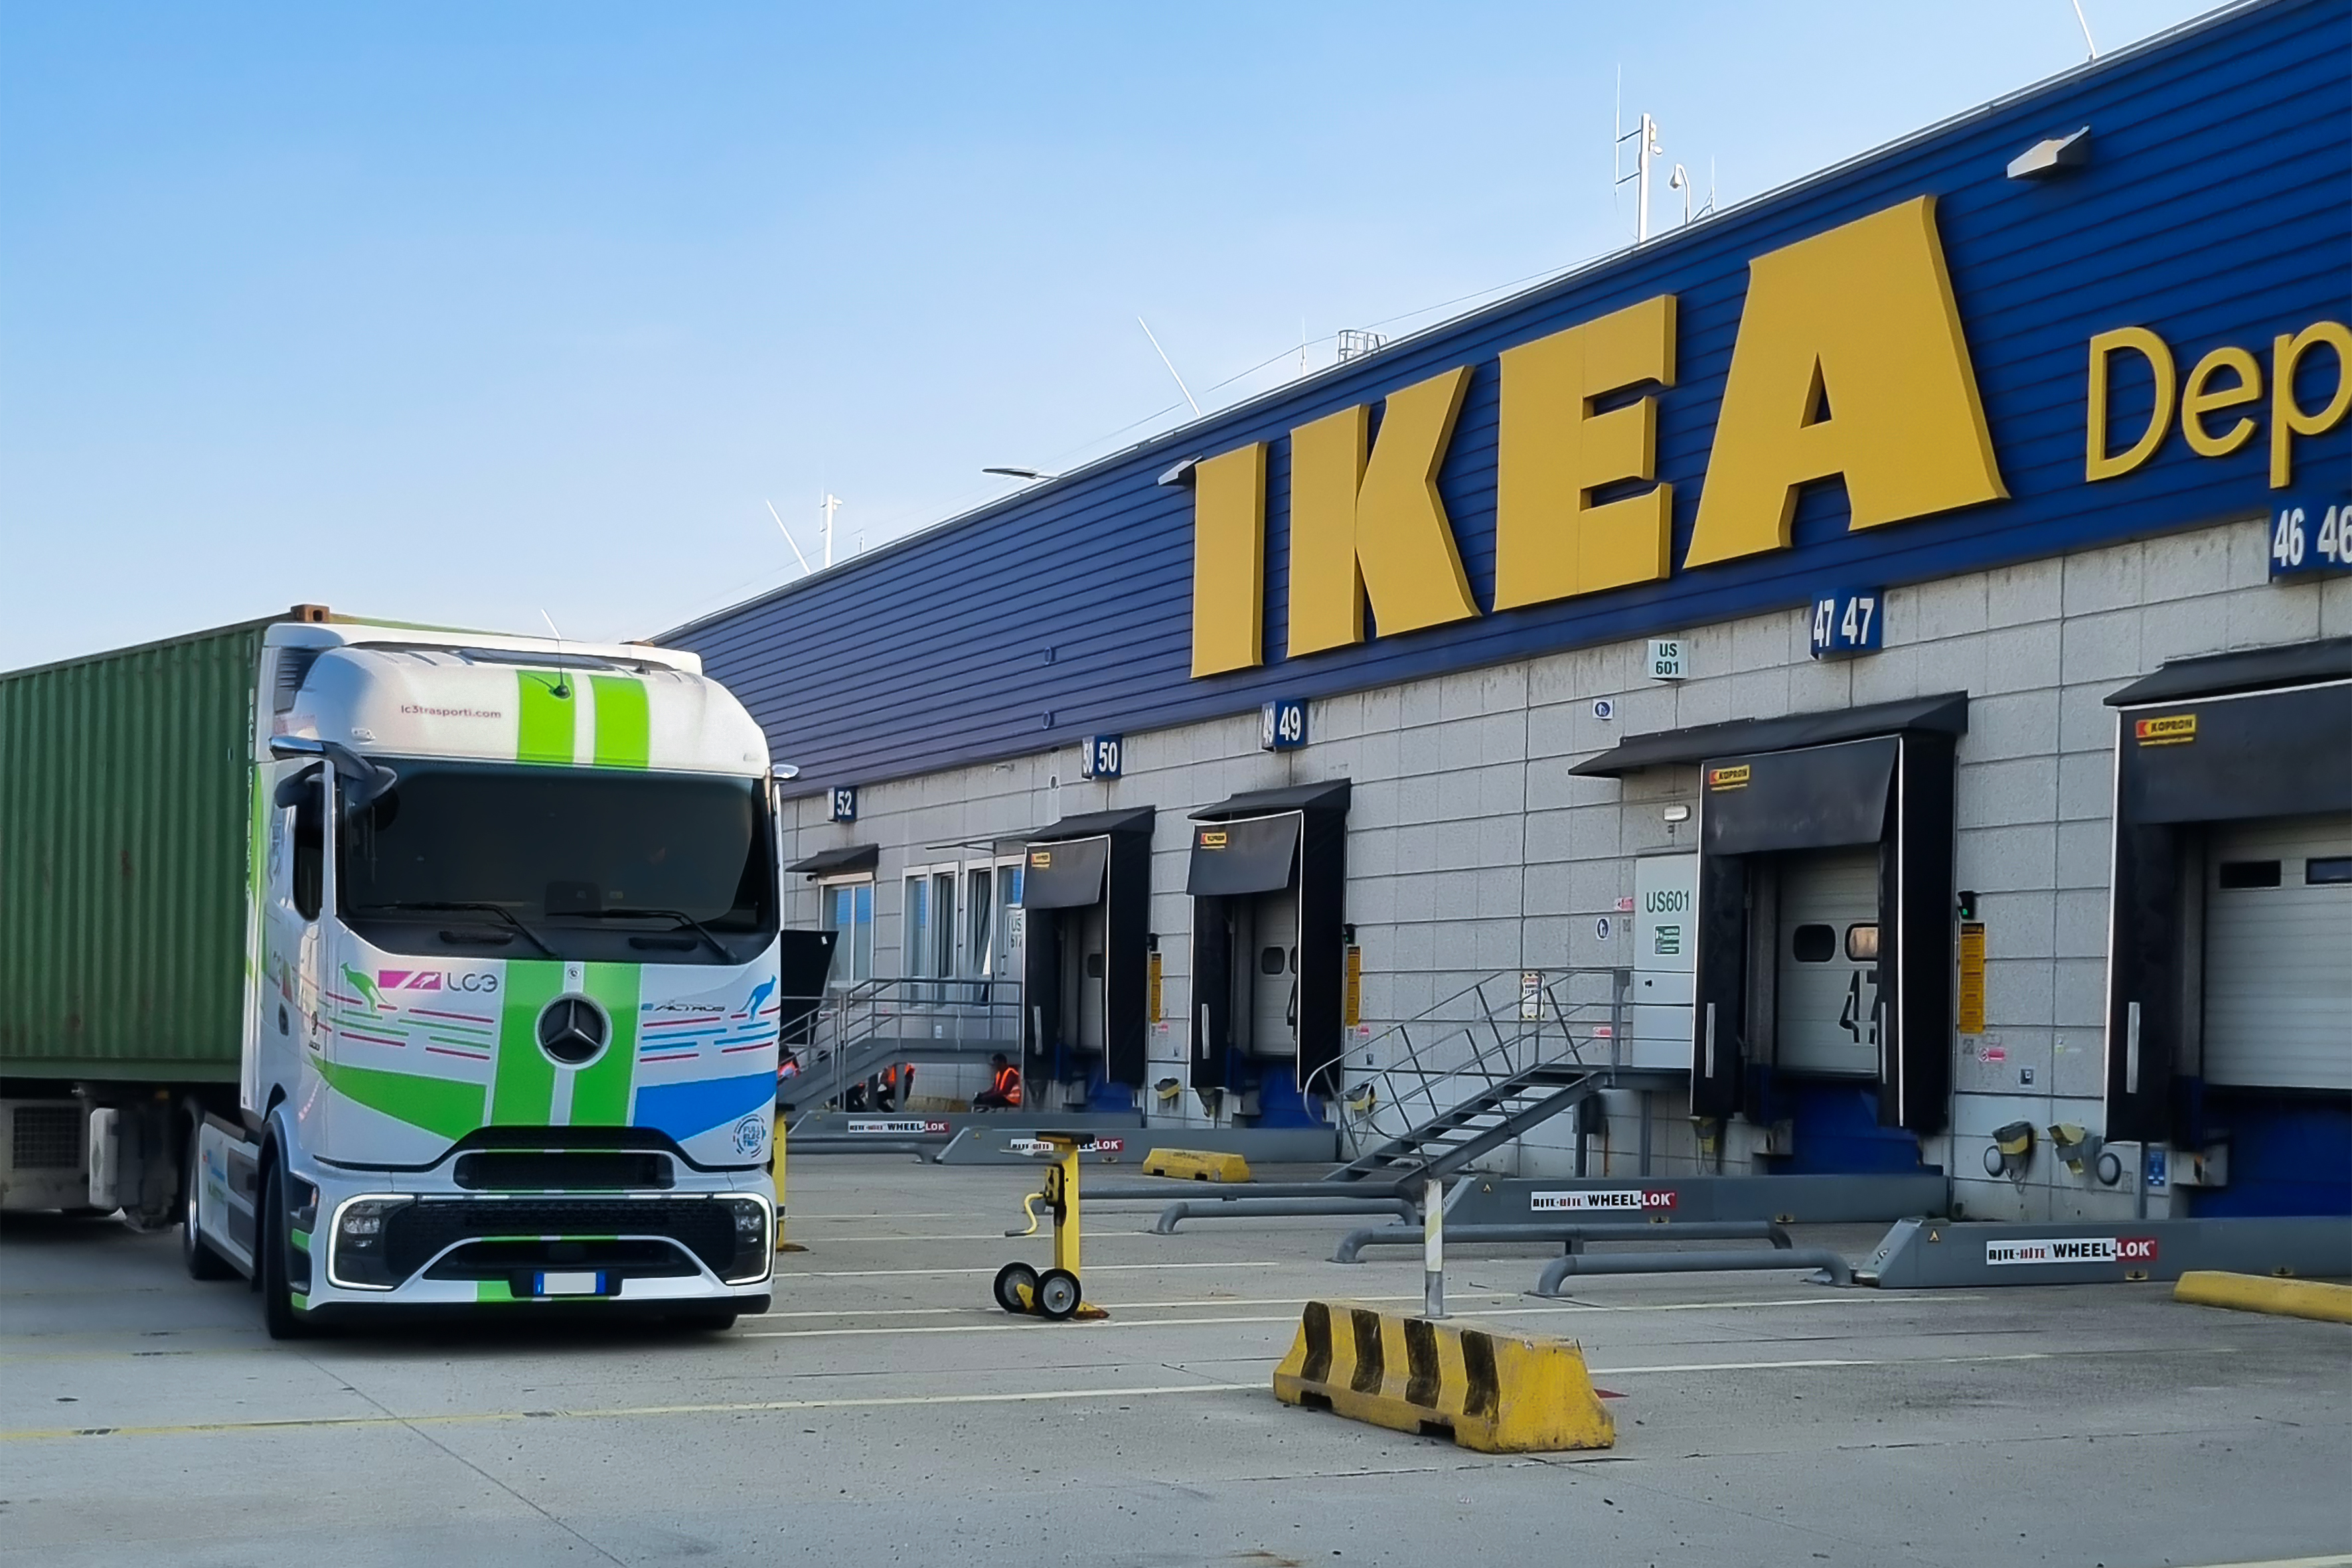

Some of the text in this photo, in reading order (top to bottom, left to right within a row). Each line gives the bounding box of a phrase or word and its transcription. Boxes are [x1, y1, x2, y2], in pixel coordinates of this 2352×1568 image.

[2086, 321, 2352, 489] Dep
[1191, 195, 2010, 678] IKEA
[2273, 508, 2304, 567] 46
[2317, 506, 2352, 564] 46
[1814, 599, 1834, 647] 47
[1842, 597, 1874, 645] 47
[1660, 643, 1678, 657] US
[1656, 661, 1678, 674] 601
[401, 704, 501, 718] lc3trasporti.com
[1263, 708, 1274, 744] 49
[1279, 706, 1301, 741] 49
[1082, 742, 1094, 774] 50
[1098, 742, 1118, 772] 50
[836, 791, 852, 815] 52
[1646, 890, 1689, 913] US601
[447, 972, 498, 992] LC3
[1588, 1193, 1671, 1207] WHEEL-LOK
[2053, 1241, 2151, 1258] WHEEL-LOK
